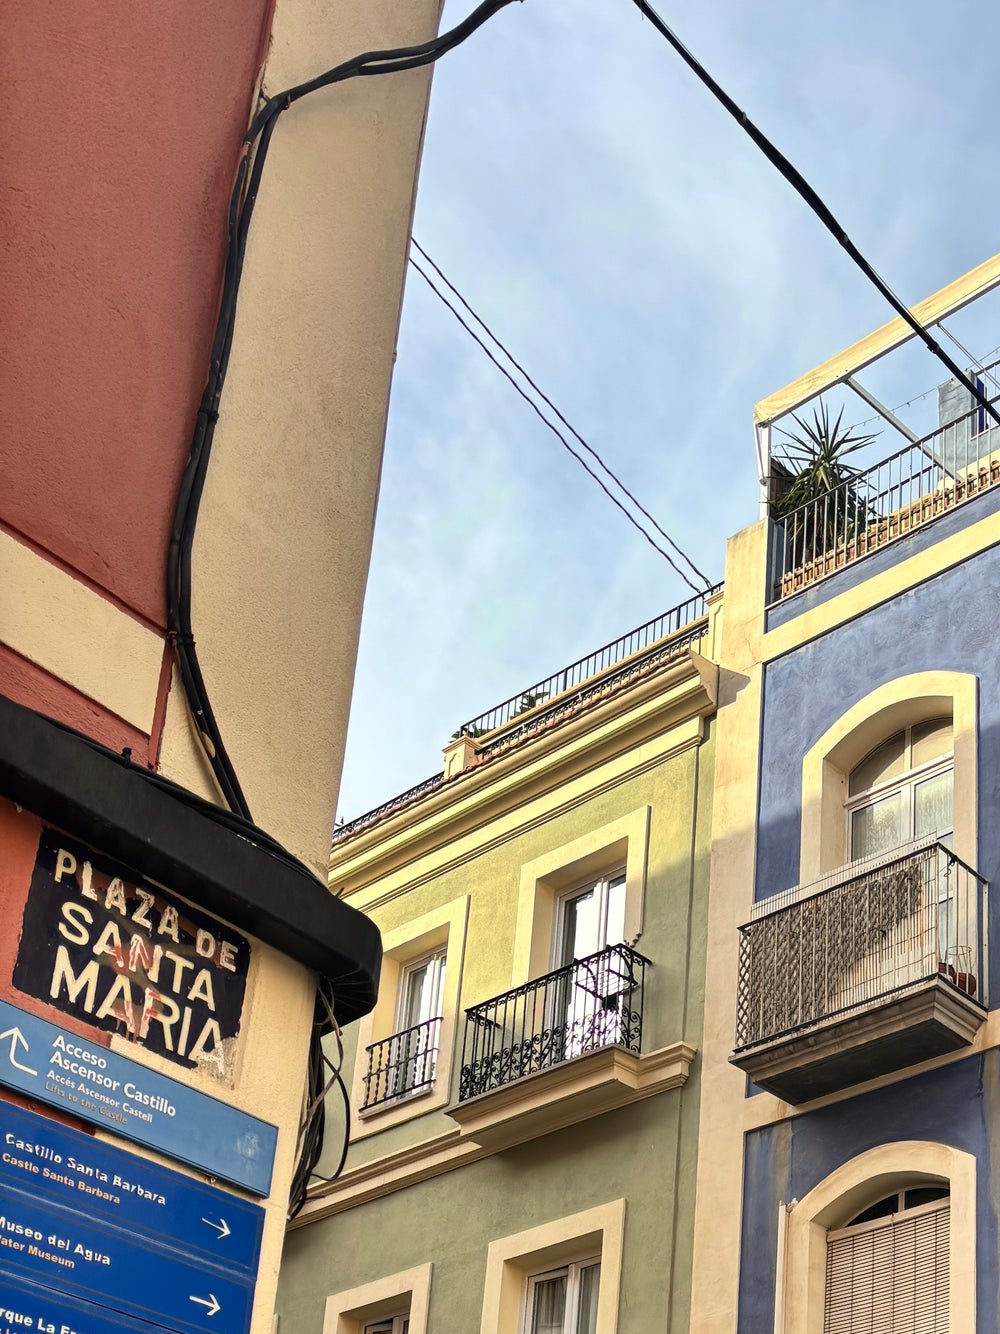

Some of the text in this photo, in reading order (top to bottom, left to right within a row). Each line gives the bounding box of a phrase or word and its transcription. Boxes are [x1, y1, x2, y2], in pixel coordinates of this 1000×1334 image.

[53, 849, 239, 973] PLAZA DE
[58, 901, 216, 1012] SANTA
[50, 945, 224, 1074] MARIA
[52, 1034, 107, 1069] Acceso
[46, 1069, 153, 1123] Accés Ascensor Castell
[49, 1051, 176, 1117] Ascensor Castillo
[67, 1092, 78, 1103] to
[81, 1098, 97, 1111] the
[98, 1105, 128, 1125] Castle
[2, 1152, 121, 1204] Castle Santa Barbara
[5, 1133, 166, 1206] Castillo Santa Barbara
[0, 1234, 75, 1269] ater Museum
[47, 1234, 70, 1251] del
[73, 1243, 111, 1265] Agua
[37, 1317, 56, 1334] La
